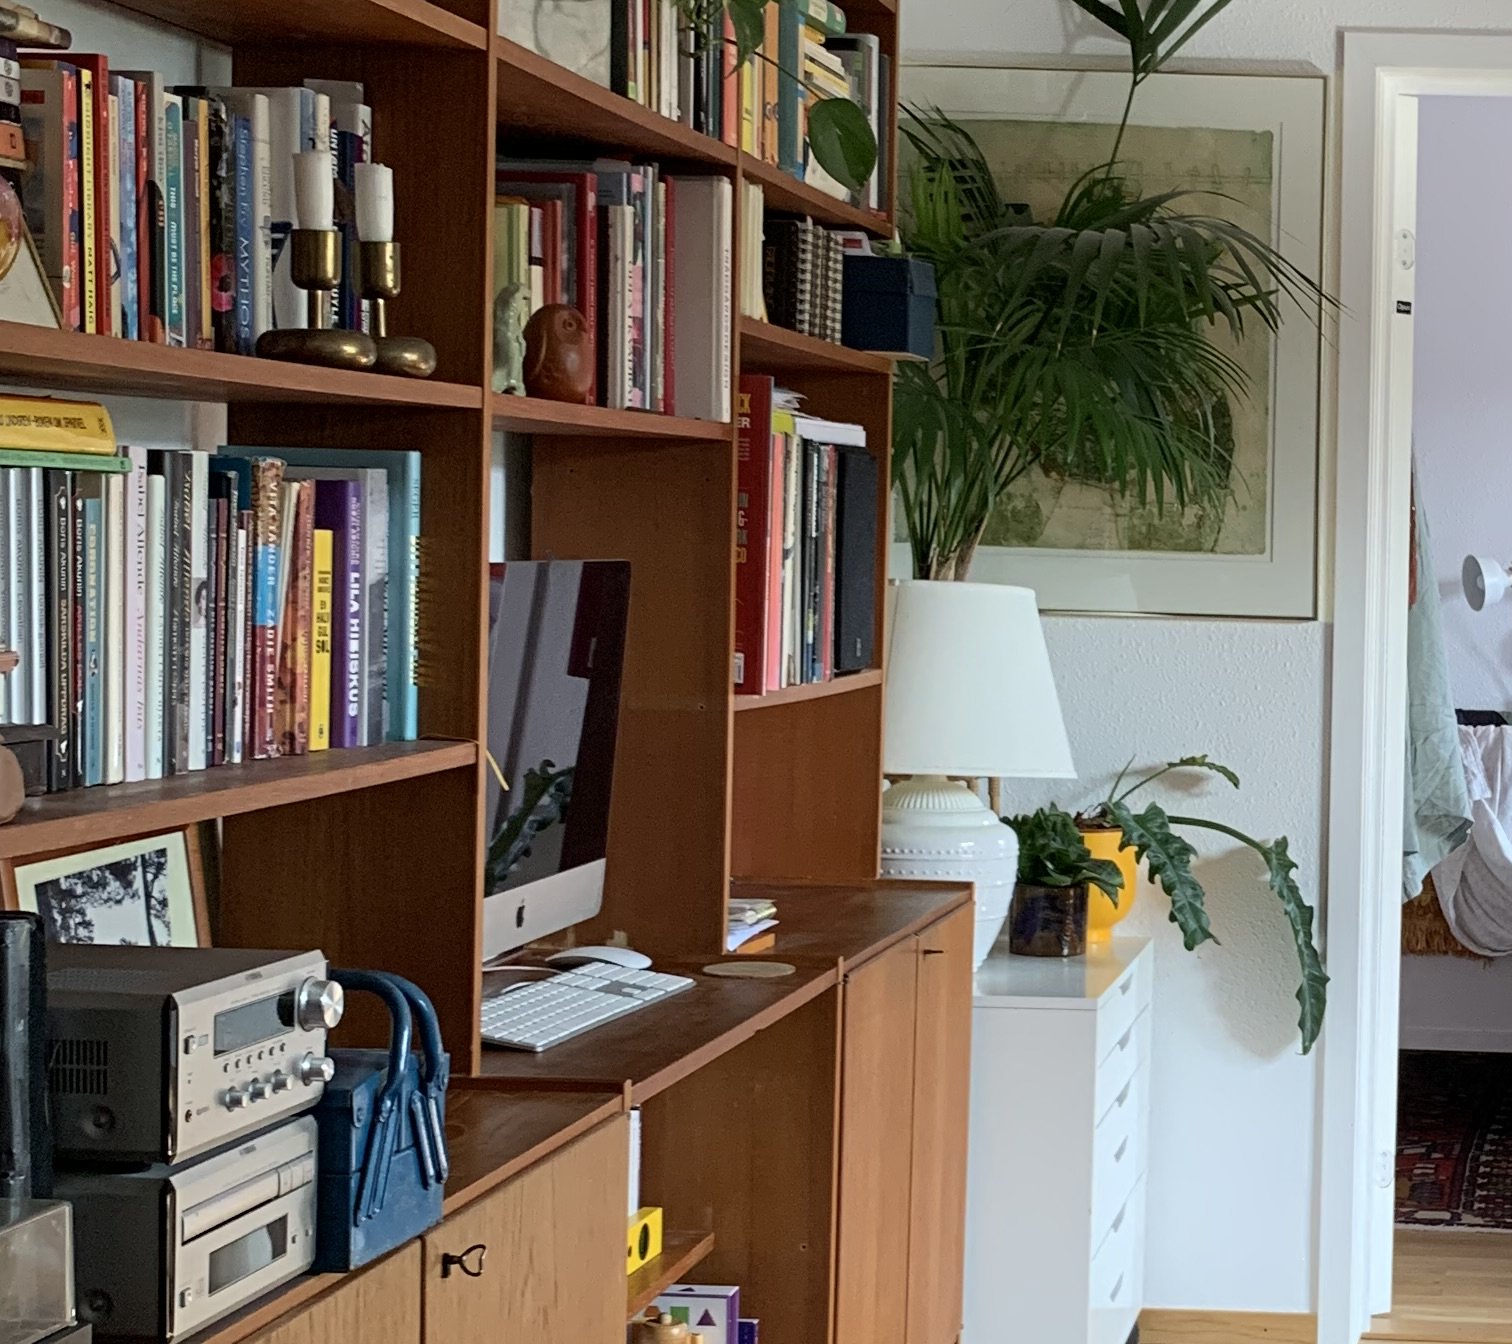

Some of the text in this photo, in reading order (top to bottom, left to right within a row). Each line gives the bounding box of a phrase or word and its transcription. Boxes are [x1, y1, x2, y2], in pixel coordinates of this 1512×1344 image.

[238, 128, 249, 225] Stephen Fry
[239, 236, 250, 338] MYTHOS
[137, 464, 145, 517] Isabel
[269, 481, 277, 516] VITA
[89, 523, 97, 642] CORONATION
[137, 523, 145, 594] Allende
[267, 608, 276, 655] ZADIE
[315, 640, 330, 653] SOL
[348, 571, 361, 716] LILA HIBISKUS
[267, 663, 275, 712] SMITH
